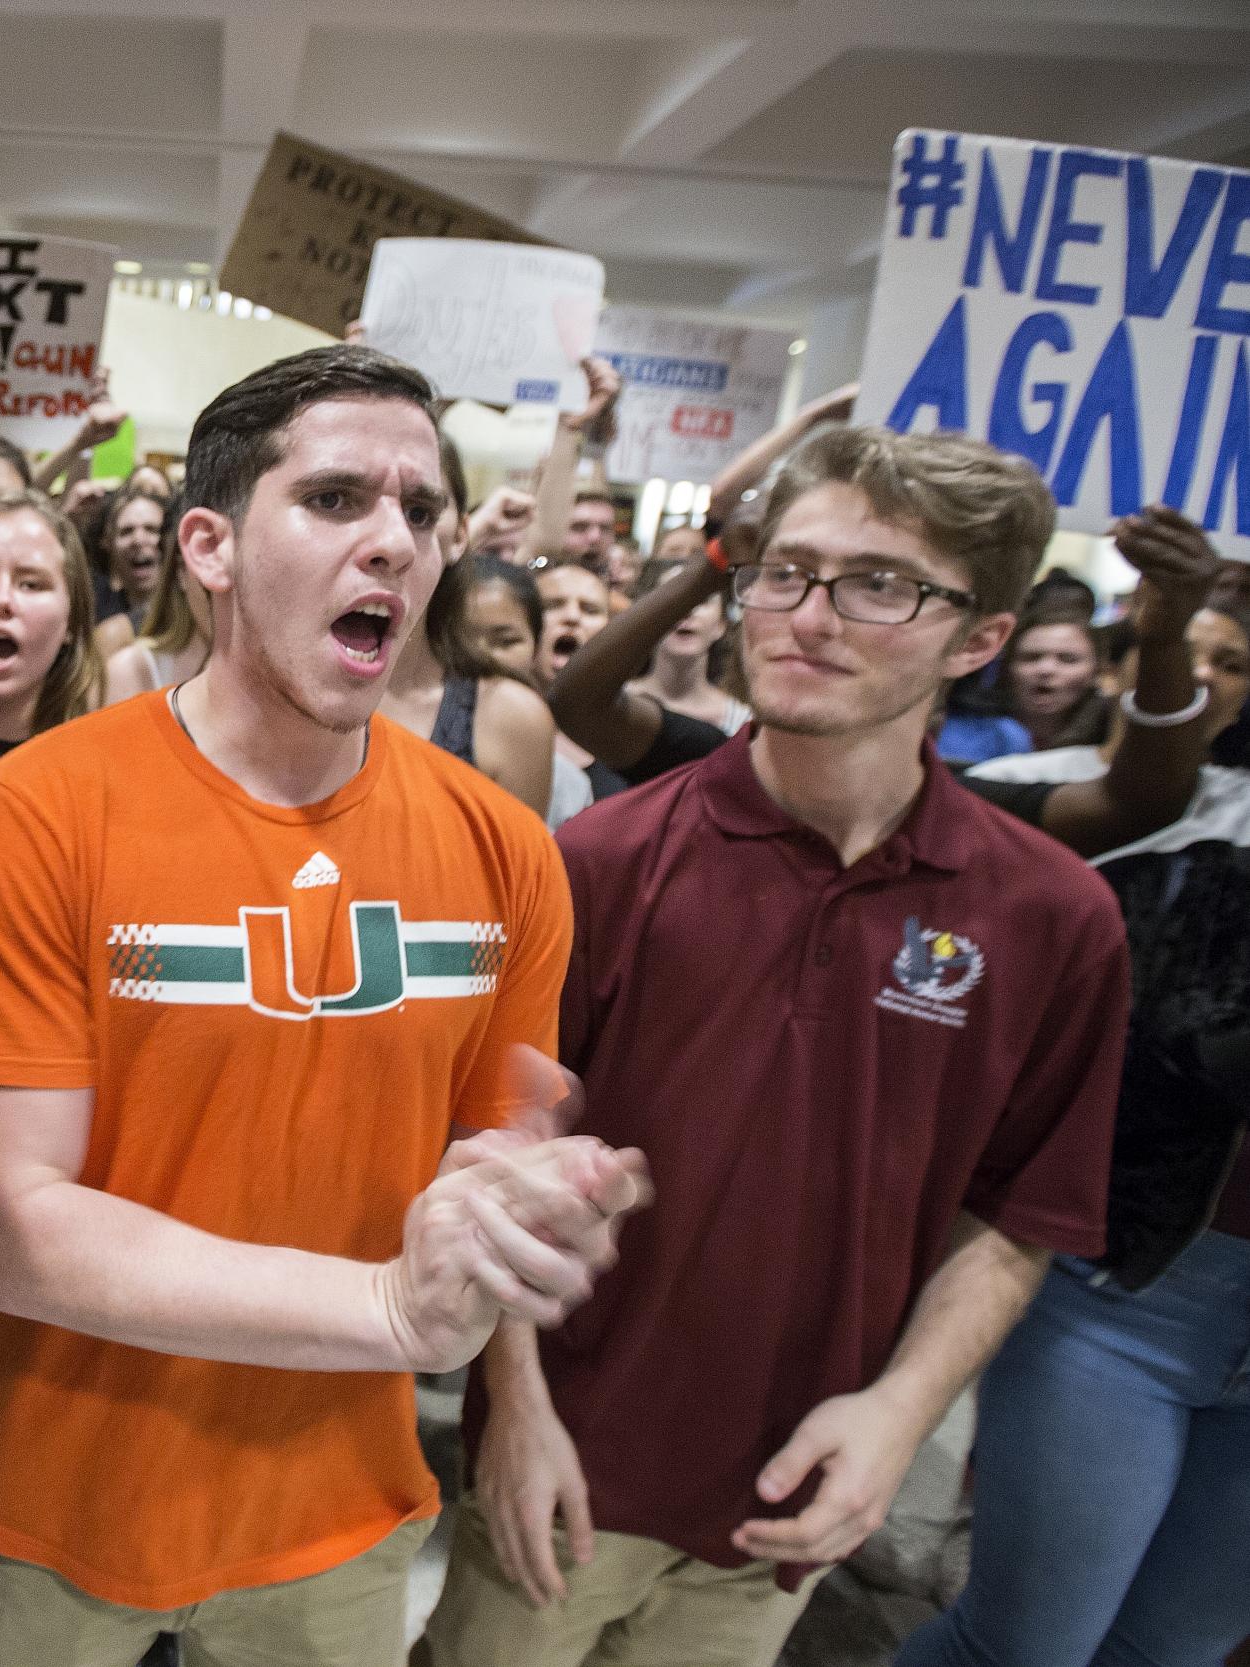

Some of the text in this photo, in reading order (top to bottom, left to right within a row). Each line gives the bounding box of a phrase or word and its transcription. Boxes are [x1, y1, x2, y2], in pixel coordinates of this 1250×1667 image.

[287, 155, 458, 237] PROTECT
[13, 339, 97, 379] GUN
[291, 868, 341, 889] adida
